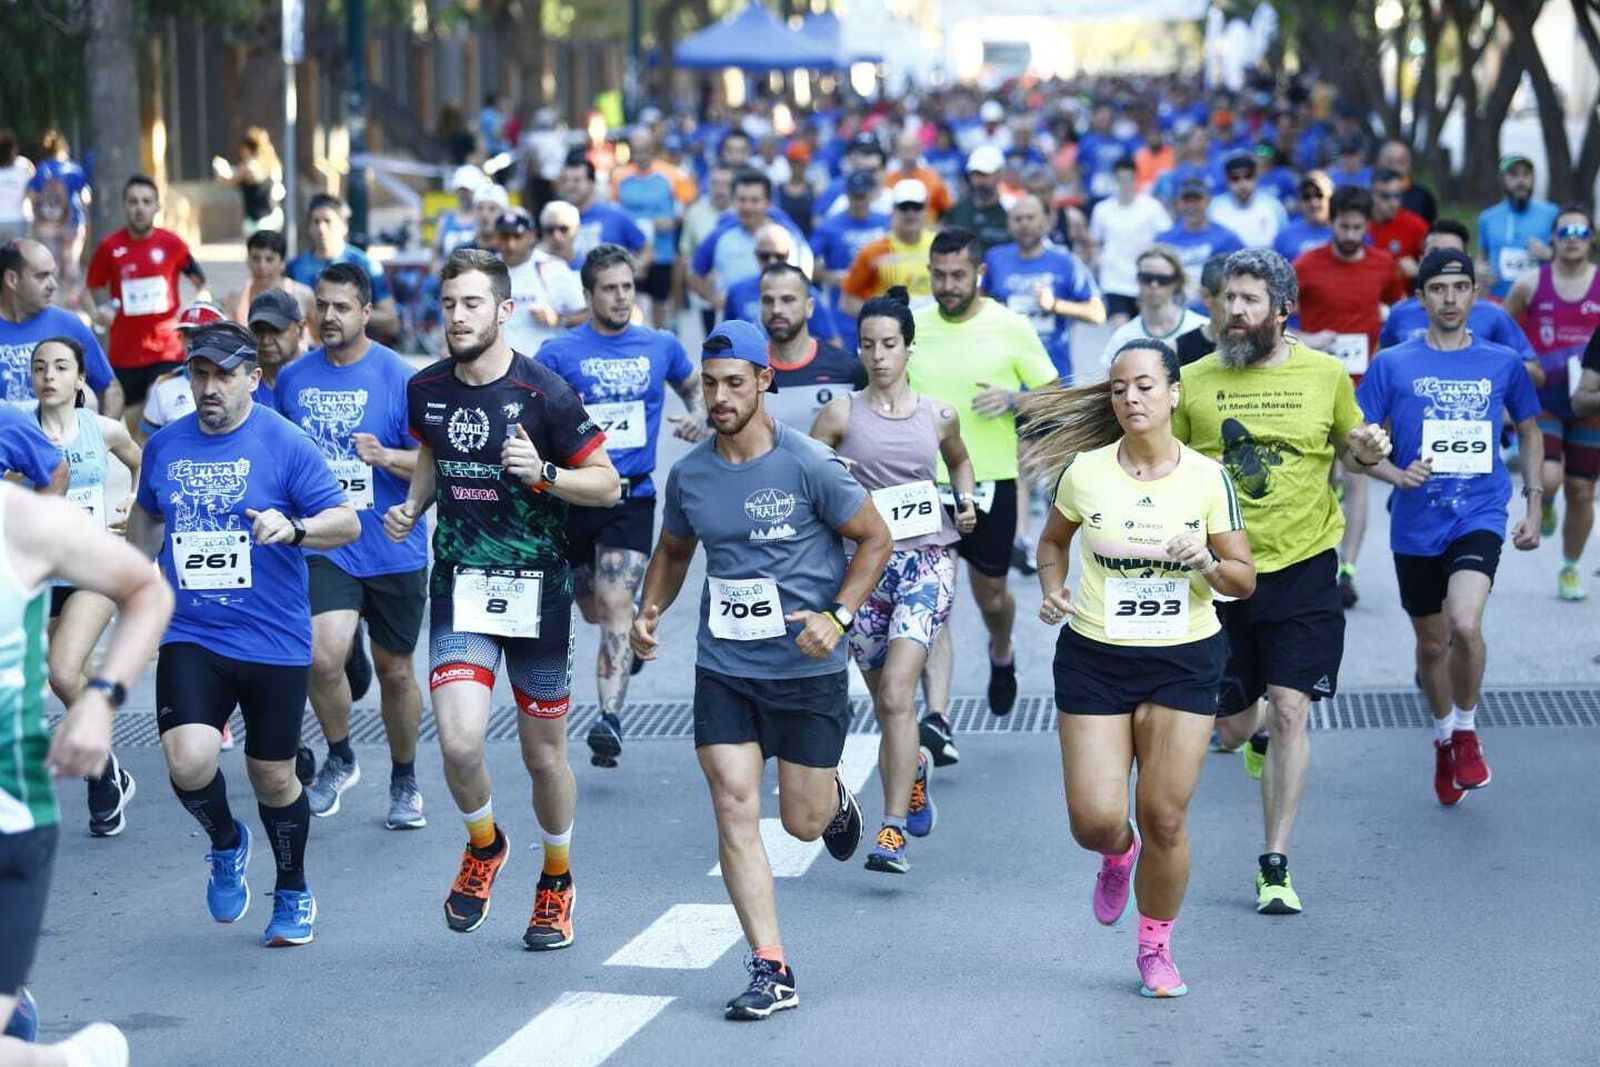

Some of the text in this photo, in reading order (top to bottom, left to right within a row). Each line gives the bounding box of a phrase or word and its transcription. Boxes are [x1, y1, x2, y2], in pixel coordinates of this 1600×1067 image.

[454, 422, 482, 435] TRAIL
[600, 420, 630, 432] 74
[1432, 440, 1486, 453] 669
[438, 460, 504, 480] FENDT
[451, 485, 498, 500] VALTRA
[892, 501, 932, 520] 178
[185, 553, 238, 569] 261
[486, 599, 508, 613] 8
[720, 600, 772, 618] 706
[1115, 600, 1181, 616] 393
[440, 669, 475, 680] AGCO
[541, 703, 568, 713] AGCO
